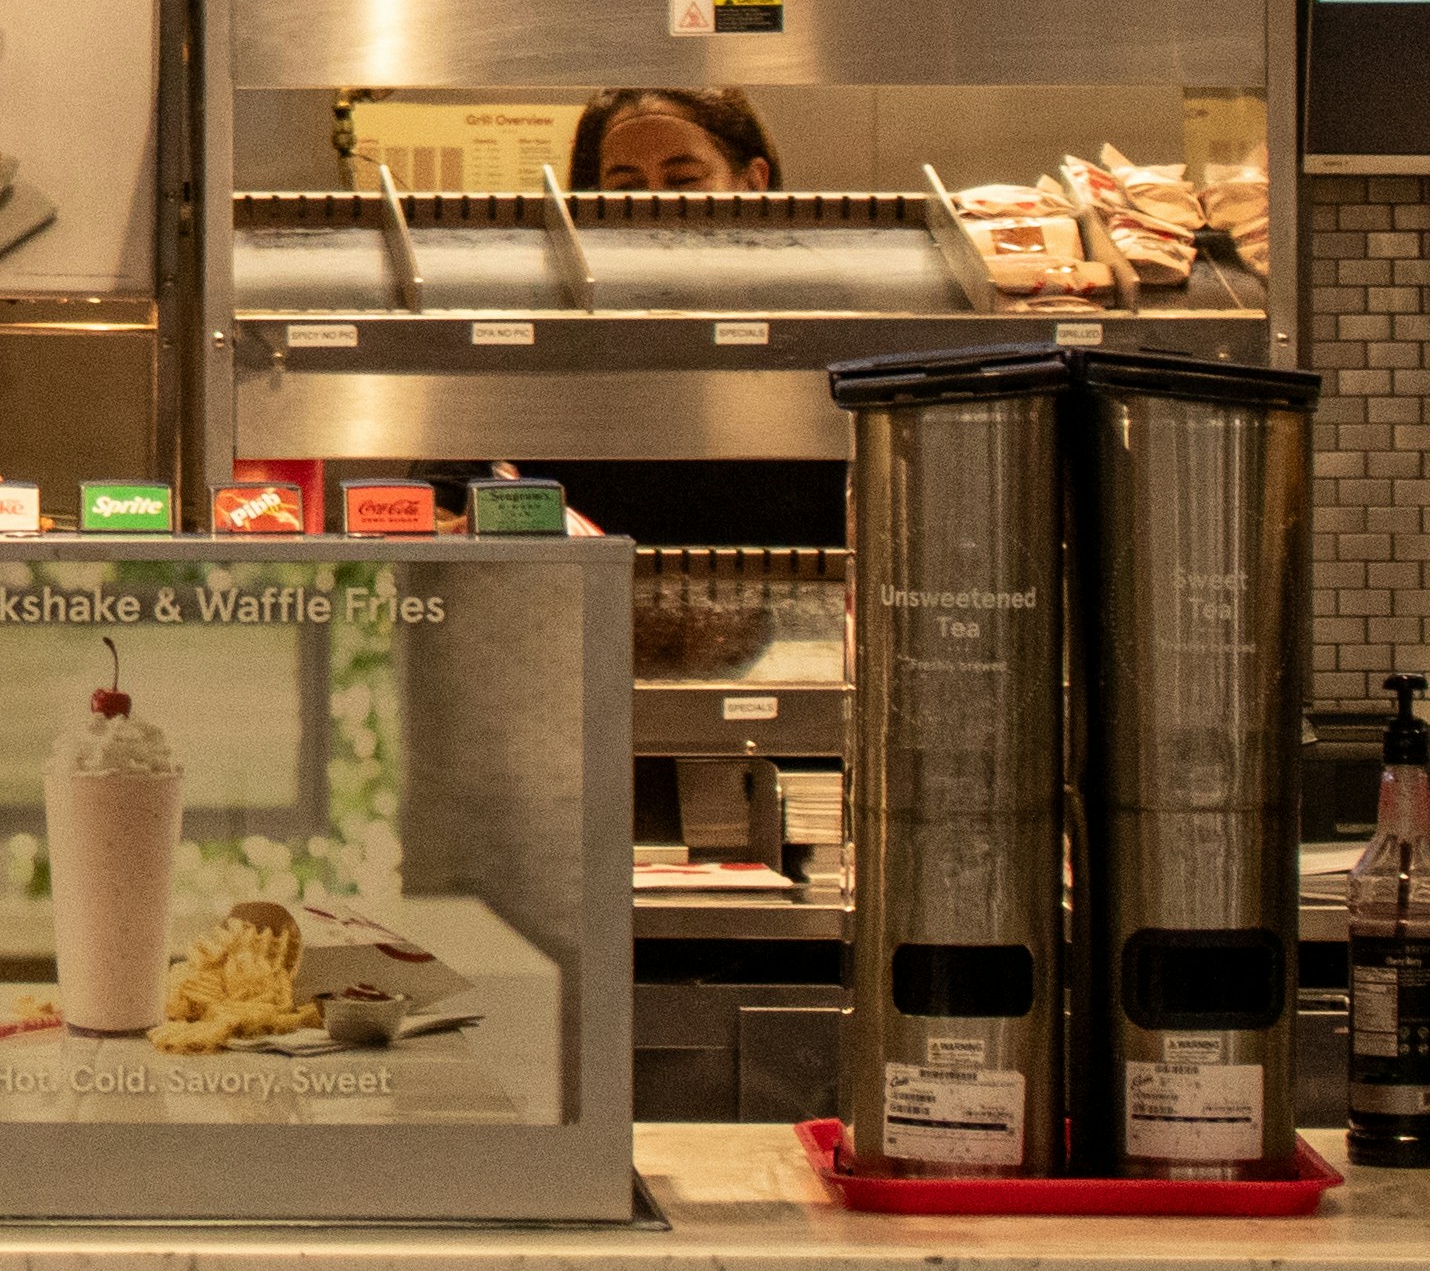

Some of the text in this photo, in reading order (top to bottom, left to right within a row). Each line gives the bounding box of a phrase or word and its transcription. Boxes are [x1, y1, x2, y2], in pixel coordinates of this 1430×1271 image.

[466, 115, 553, 125] Grill Overview
[92, 496, 163, 516] Sprite
[358, 500, 420, 516] Coca-Cola
[154, 589, 183, 622] &
[196, 586, 331, 623] Waffle
[344, 587, 445, 625] Fries
[881, 586, 1037, 609] Unsweetened
[937, 617, 980, 638] Tea
[941, 1042, 982, 1052] WARNING
[1177, 1040, 1219, 1050] WARNING
[68, 1064, 154, 1095] Cold.
[167, 1064, 283, 1100] Savory.
[291, 1064, 392, 1097] Sweet
